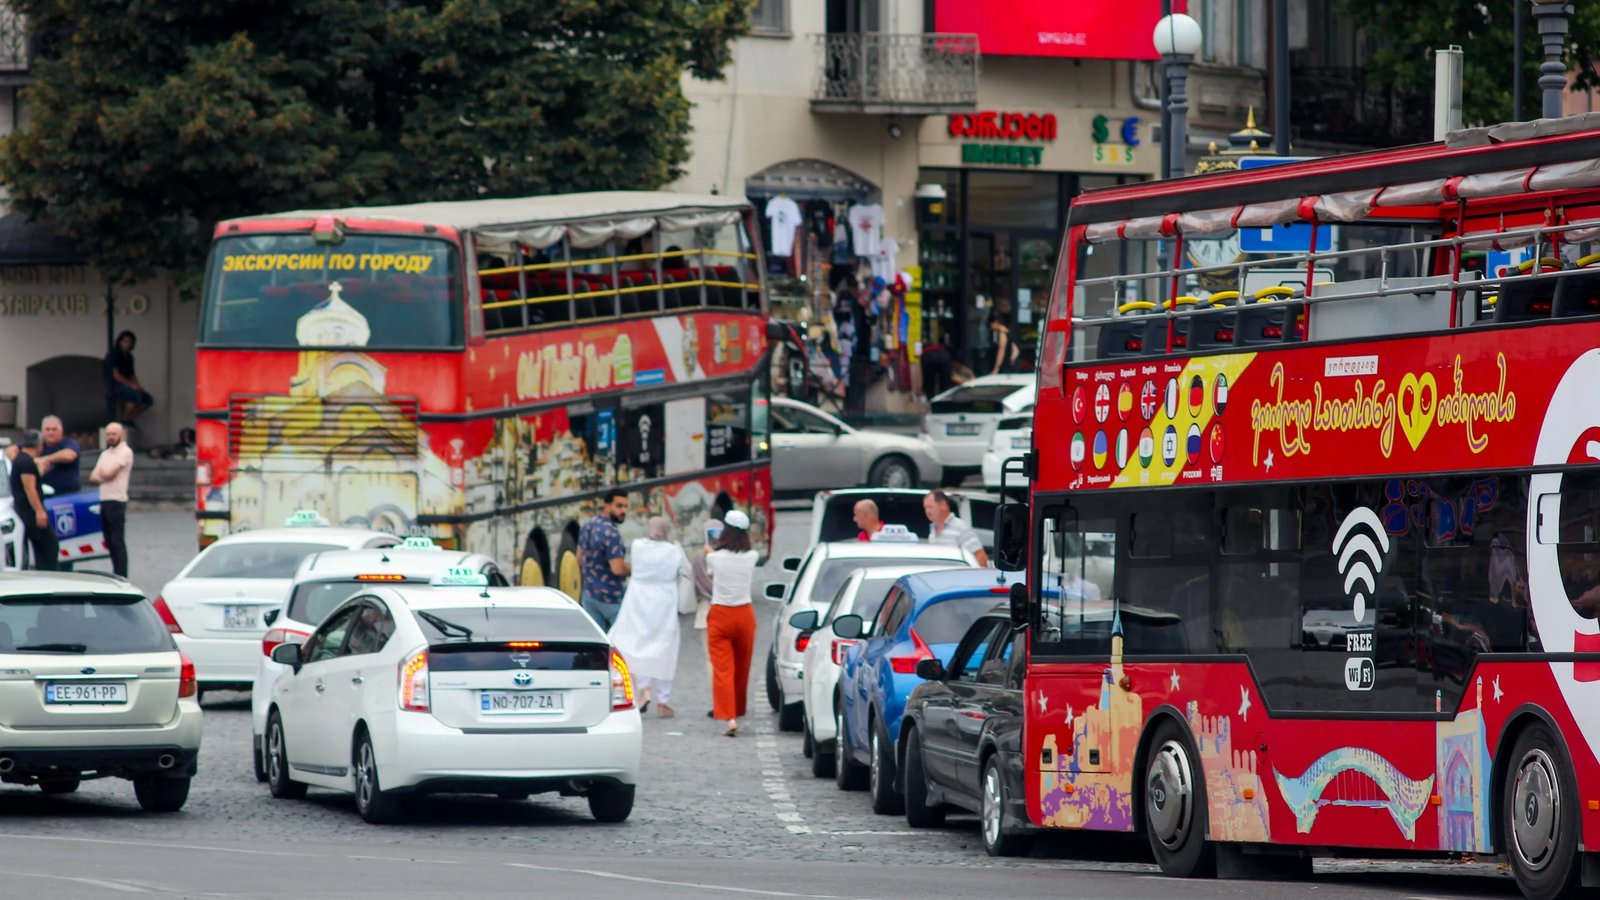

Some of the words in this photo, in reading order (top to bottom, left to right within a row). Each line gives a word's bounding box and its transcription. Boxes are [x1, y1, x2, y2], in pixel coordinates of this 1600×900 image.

[962, 144, 1044, 165] MARKET
[223, 254, 326, 271] ЭКСКУРСИИ
[329, 254, 355, 270] ПО
[359, 254, 433, 274] ГОРОДУ
[1437, 352, 1517, 454] თბილისი
[296, 512, 317, 520] TAXI
[408, 540, 430, 548] TAXI
[448, 567, 473, 576] TAXI
[1347, 634, 1372, 652] FREE
[56, 686, 117, 699] EE-961-PP
